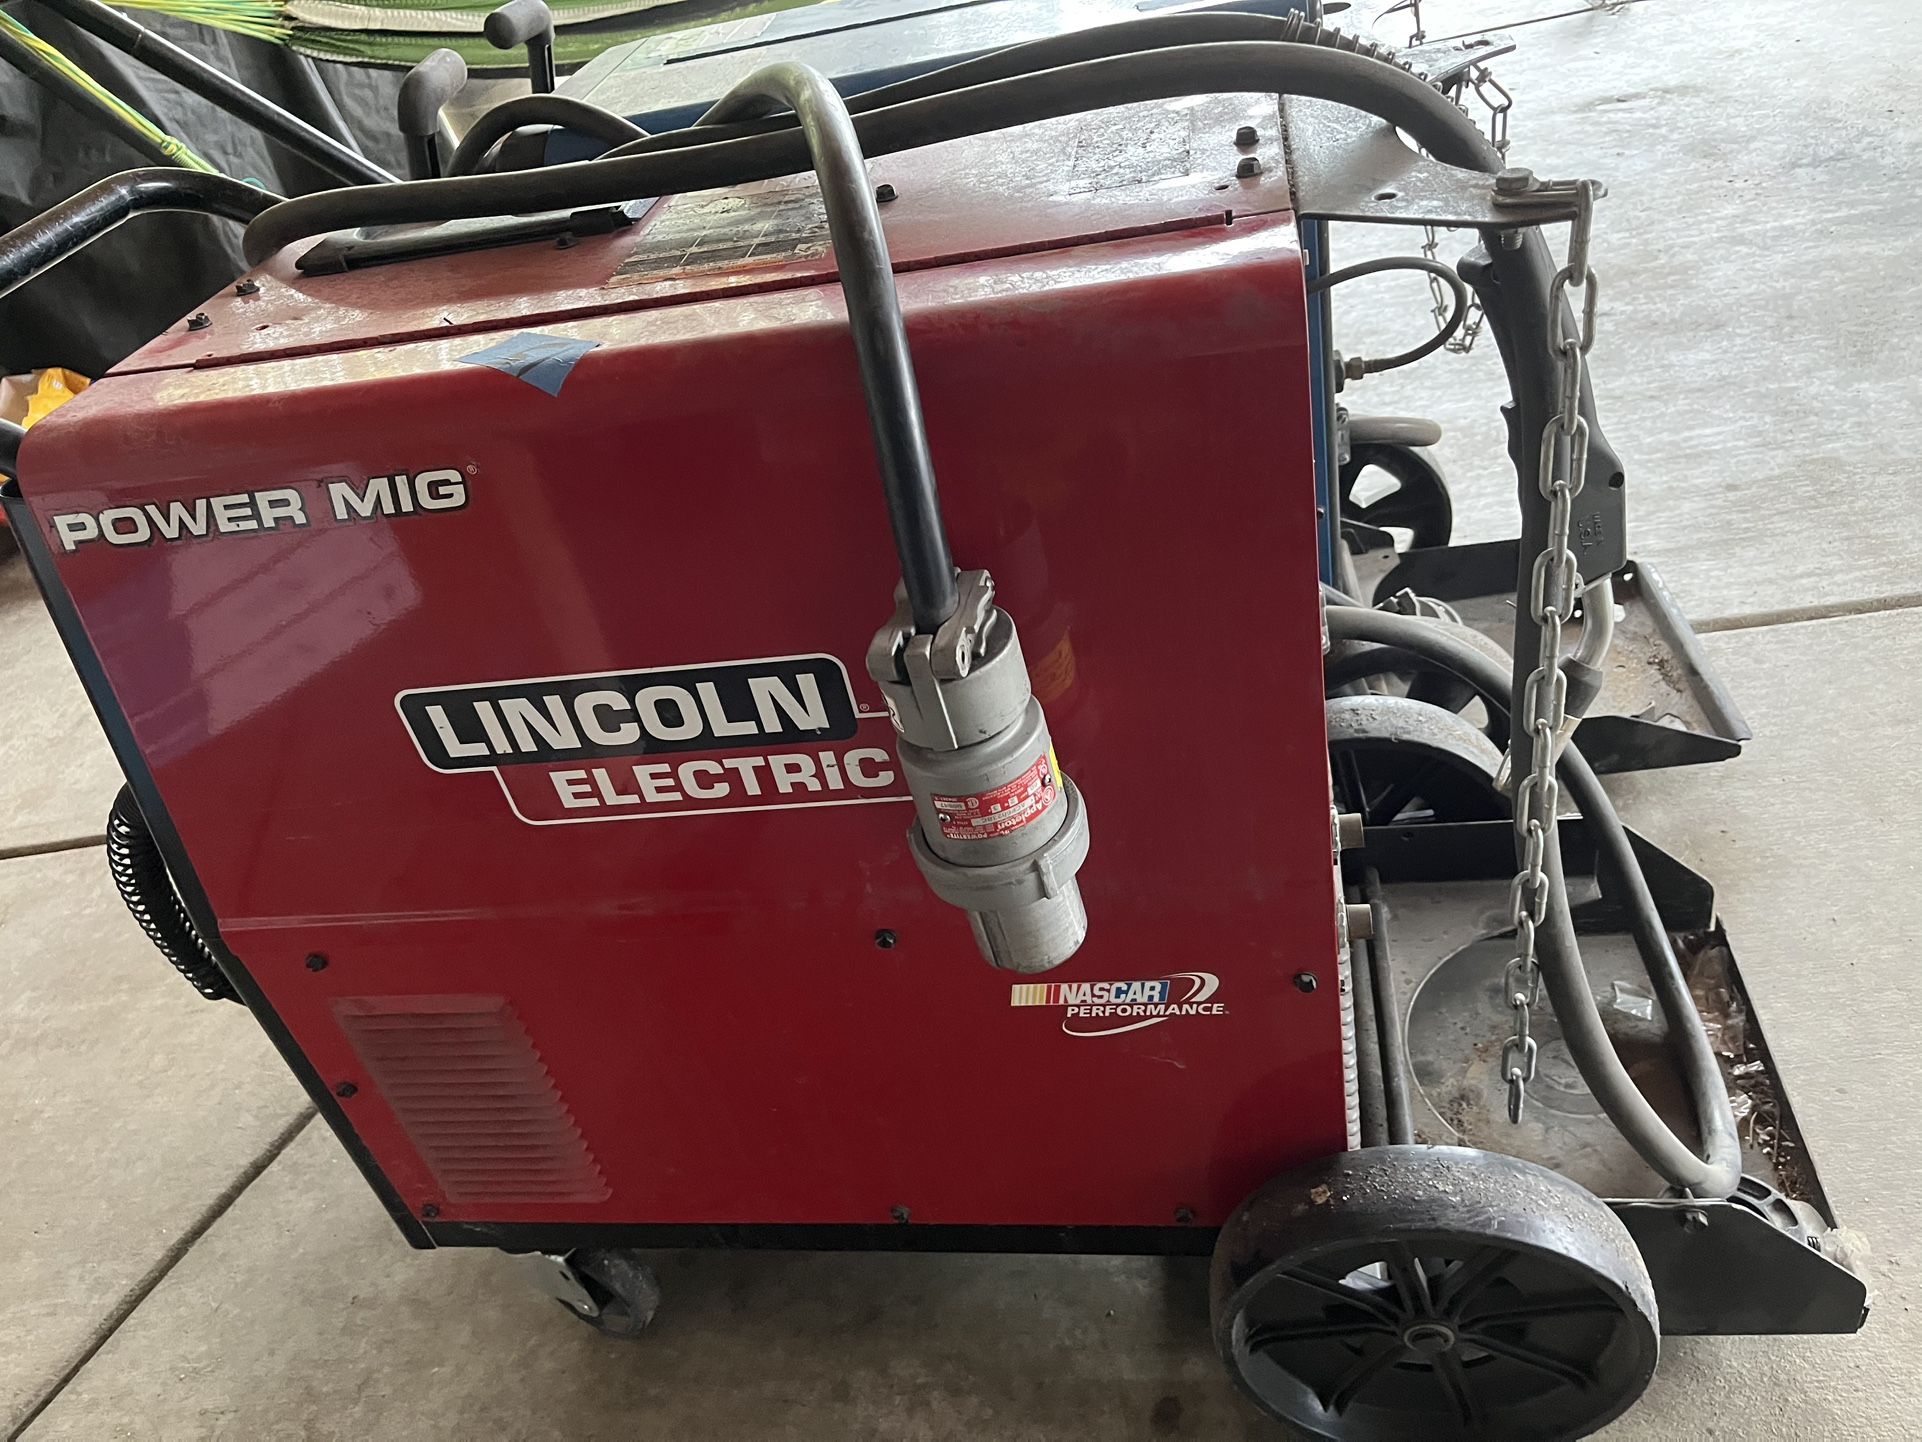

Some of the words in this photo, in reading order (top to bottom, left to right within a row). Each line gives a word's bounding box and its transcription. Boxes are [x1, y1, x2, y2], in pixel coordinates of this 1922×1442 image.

[52, 488, 308, 551] POWER
[327, 468, 467, 521] MIG
[424, 672, 830, 759] LINCOLN
[547, 747, 896, 809] ELECTRIC
[997, 800, 1043, 830] Appleton
[1059, 980, 1162, 1004] NASCAR
[1066, 1003, 1225, 1018] PERFORMANCE
